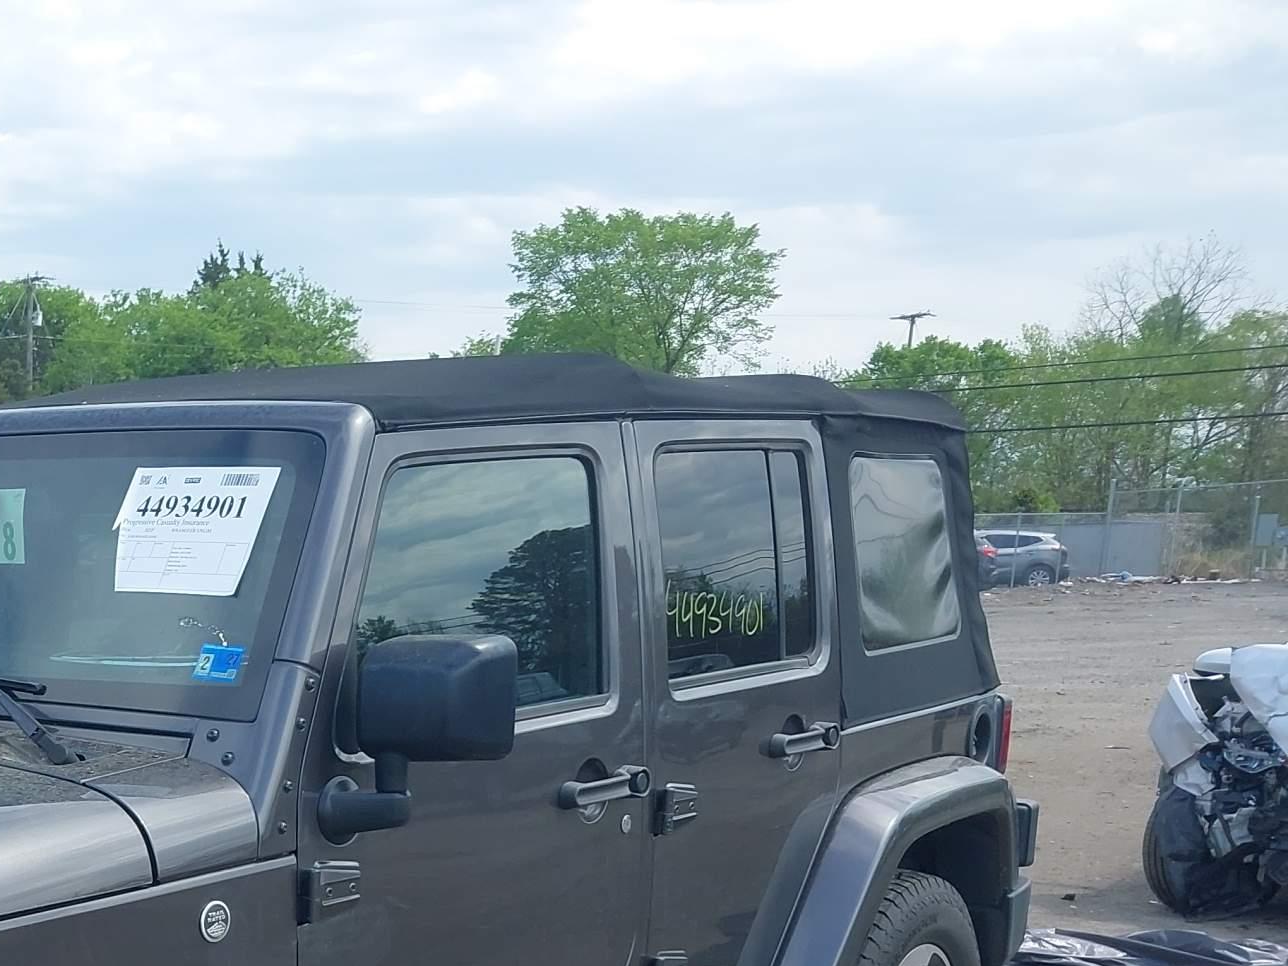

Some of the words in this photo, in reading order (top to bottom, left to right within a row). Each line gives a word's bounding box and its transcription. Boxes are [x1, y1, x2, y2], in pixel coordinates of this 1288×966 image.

[136, 495, 248, 518] 44934901
[665, 579, 763, 638] 44934901
[200, 656, 210, 670] 2
